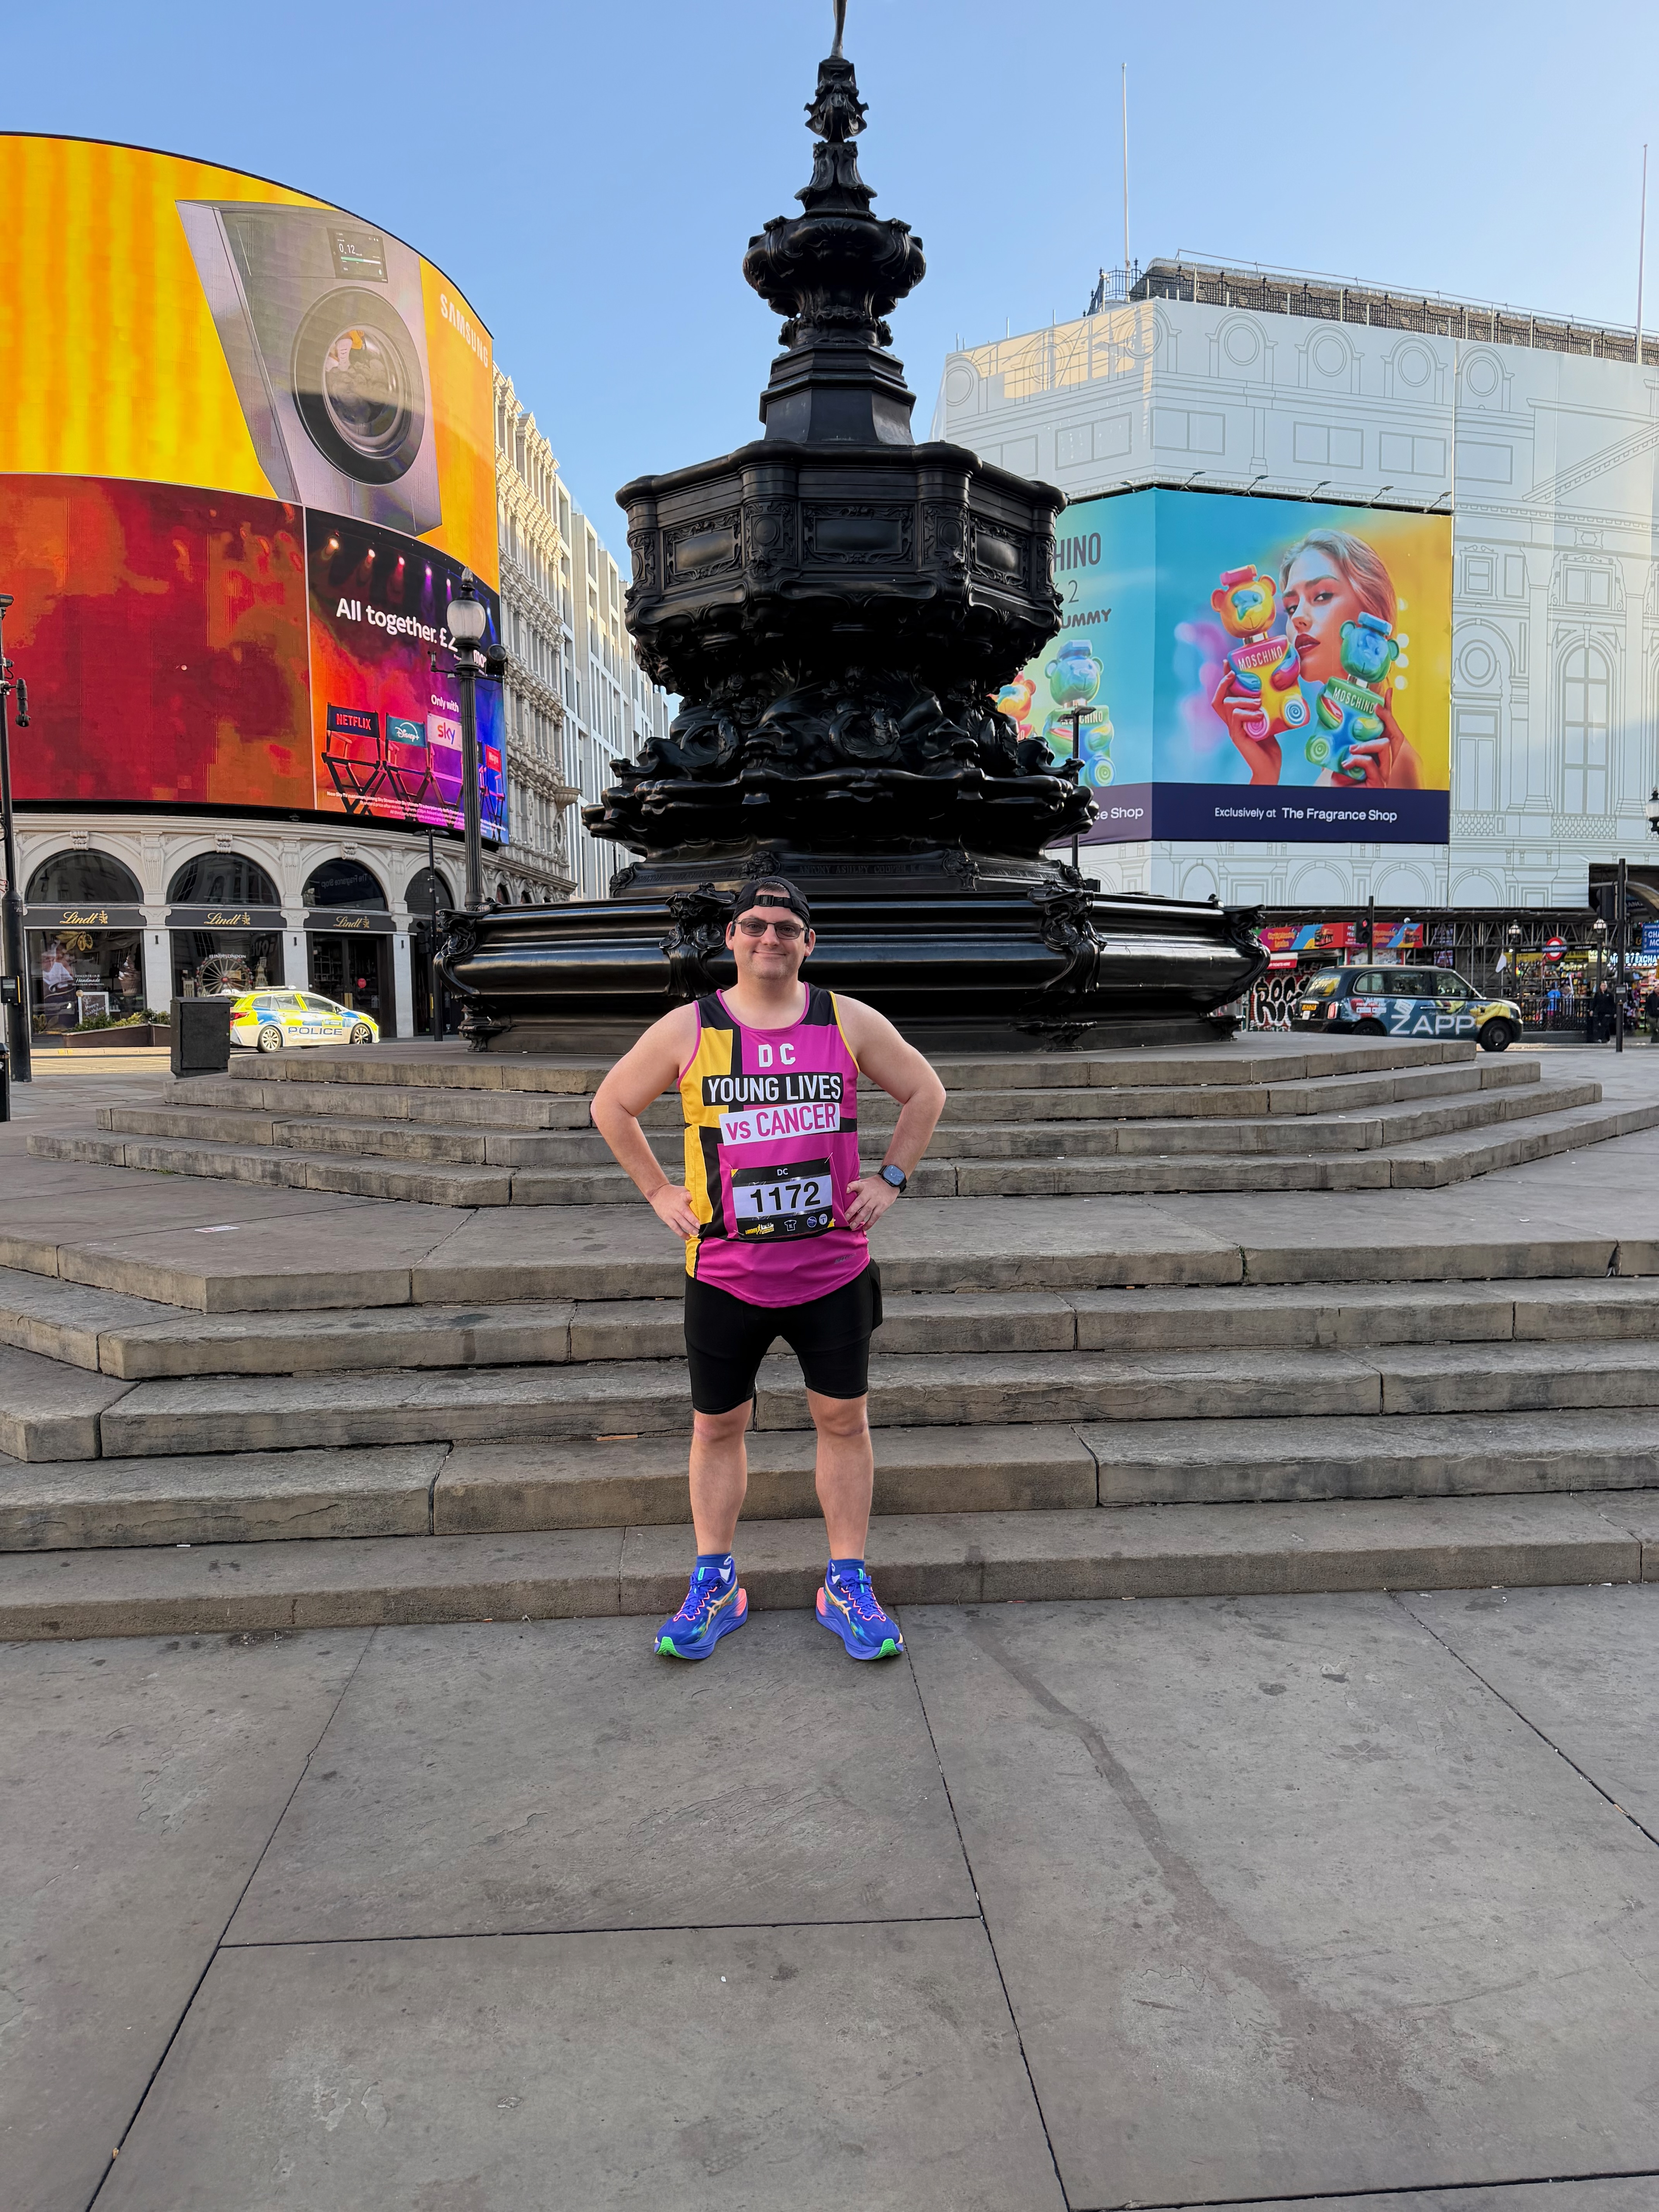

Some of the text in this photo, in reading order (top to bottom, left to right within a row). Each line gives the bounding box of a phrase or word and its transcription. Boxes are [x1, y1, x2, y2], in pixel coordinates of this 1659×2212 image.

[440, 294, 488, 368] SAMSUNG
[1053, 532, 1101, 572] HINO
[1068, 580, 1079, 603] 2
[336, 598, 361, 622] All
[366, 605, 437, 644] together.
[1062, 608, 1111, 629] UMMY
[1238, 646, 1283, 671] MOSCHINO
[431, 694, 459, 713] Only with
[1333, 687, 1374, 714] MOSCHINO
[337, 713, 371, 730] NETFLIX
[437, 722, 455, 745] sky
[1111, 807, 1144, 819] Shop
[1215, 807, 1397, 823] Exclusively at The Fragrance Shop
[59, 911, 99, 924] Lindt
[204, 912, 241, 924] Lindt
[333, 916, 362, 927] Lindt
[708, 1075, 841, 1103] YOUNG LIVES
[756, 1103, 836, 1137] CANCER
[777, 1168, 788, 1176] DC
[750, 1182, 820, 1212] 1172
